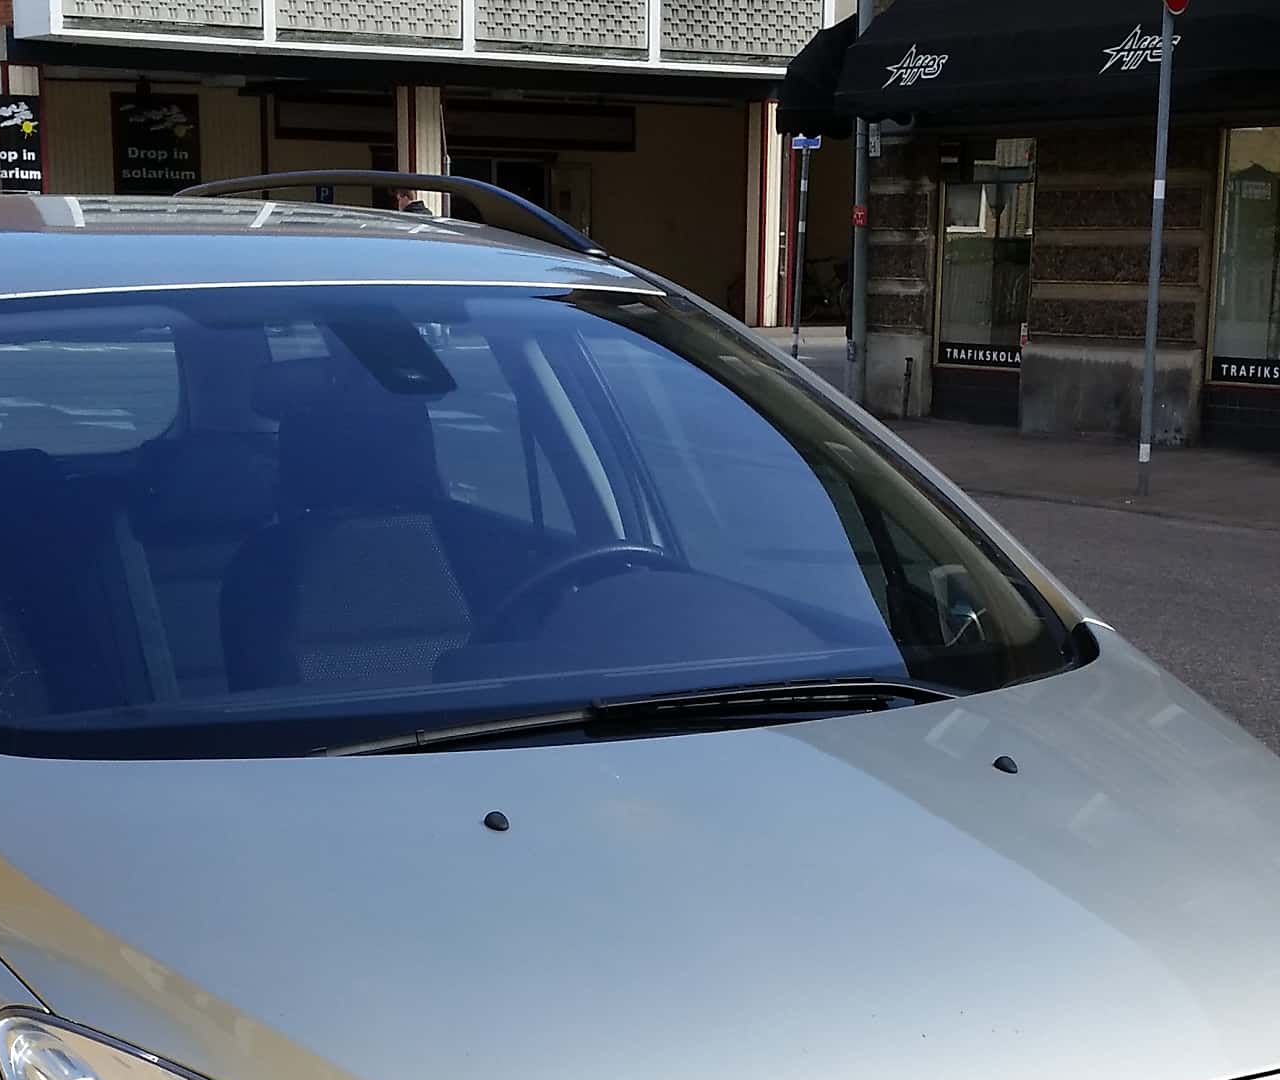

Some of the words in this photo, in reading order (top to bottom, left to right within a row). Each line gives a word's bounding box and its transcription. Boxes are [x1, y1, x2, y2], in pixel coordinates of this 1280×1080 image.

[22, 149, 36, 161] in
[127, 147, 168, 161] Drop
[173, 147, 189, 159] in
[122, 167, 196, 180] solarium
[946, 348, 1021, 362] TRAFIKSKOLA
